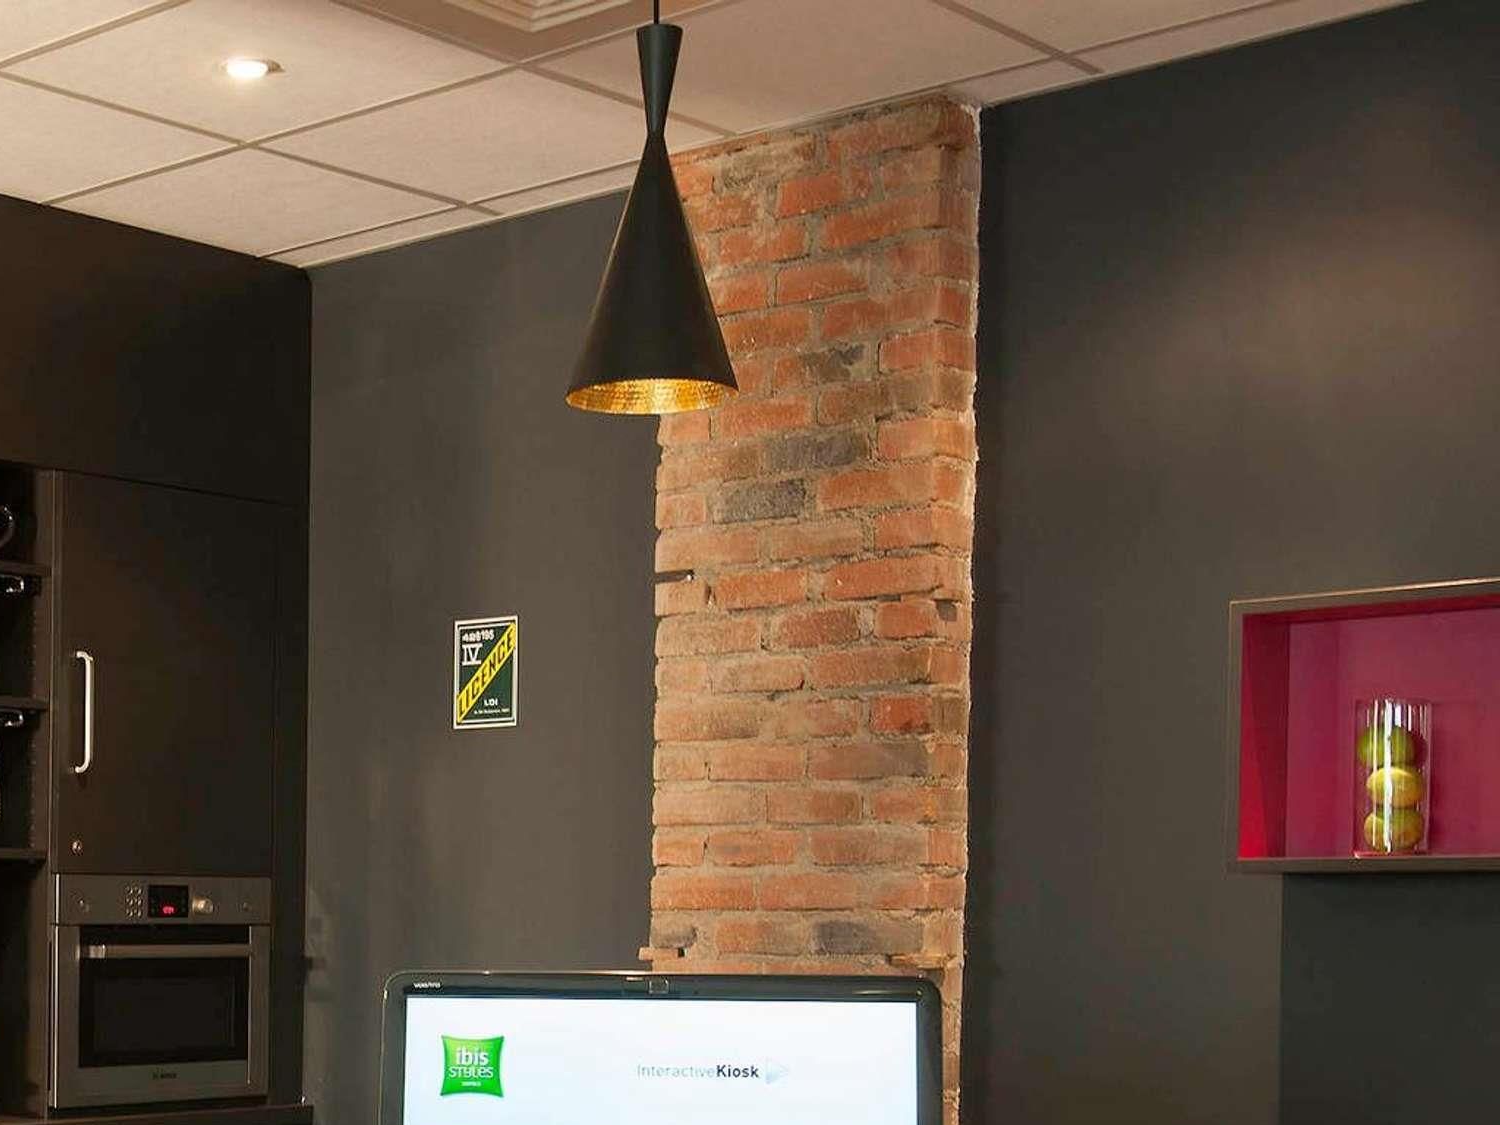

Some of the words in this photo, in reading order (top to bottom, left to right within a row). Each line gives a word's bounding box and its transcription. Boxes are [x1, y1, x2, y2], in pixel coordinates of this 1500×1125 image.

[462, 643, 483, 666] IV
[459, 628, 516, 716] LICENCE
[456, 1046, 489, 1066] ibis
